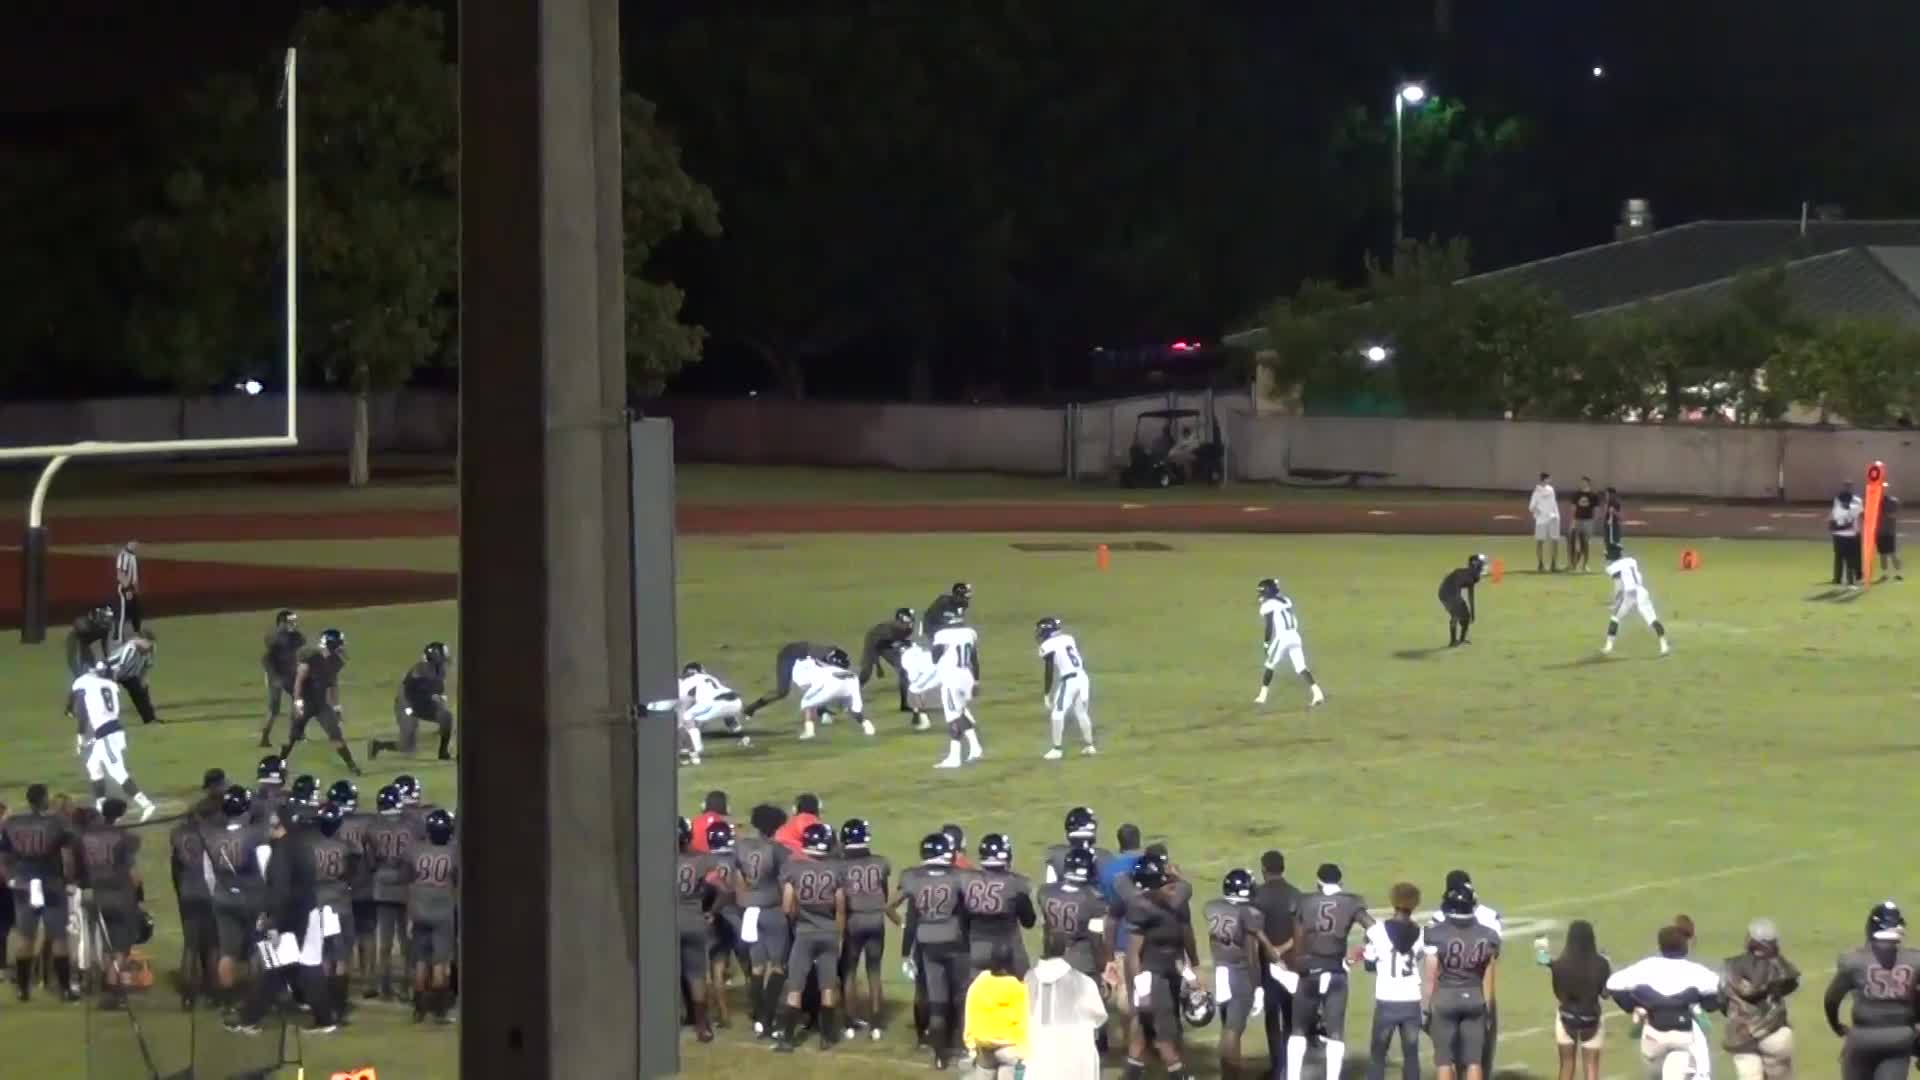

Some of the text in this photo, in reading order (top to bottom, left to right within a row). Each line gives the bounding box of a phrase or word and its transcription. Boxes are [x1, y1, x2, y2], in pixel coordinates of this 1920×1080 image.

[1867, 465, 1880, 482] 0
[956, 642, 972, 668] 10
[799, 870, 834, 904] 82
[847, 864, 882, 896] 30
[965, 879, 1006, 914] 65
[915, 882, 952, 920] 42
[1046, 898, 1080, 934] 56
[1316, 900, 1337, 935] 5
[1206, 912, 1238, 946] 25
[1389, 948, 1414, 979] 13
